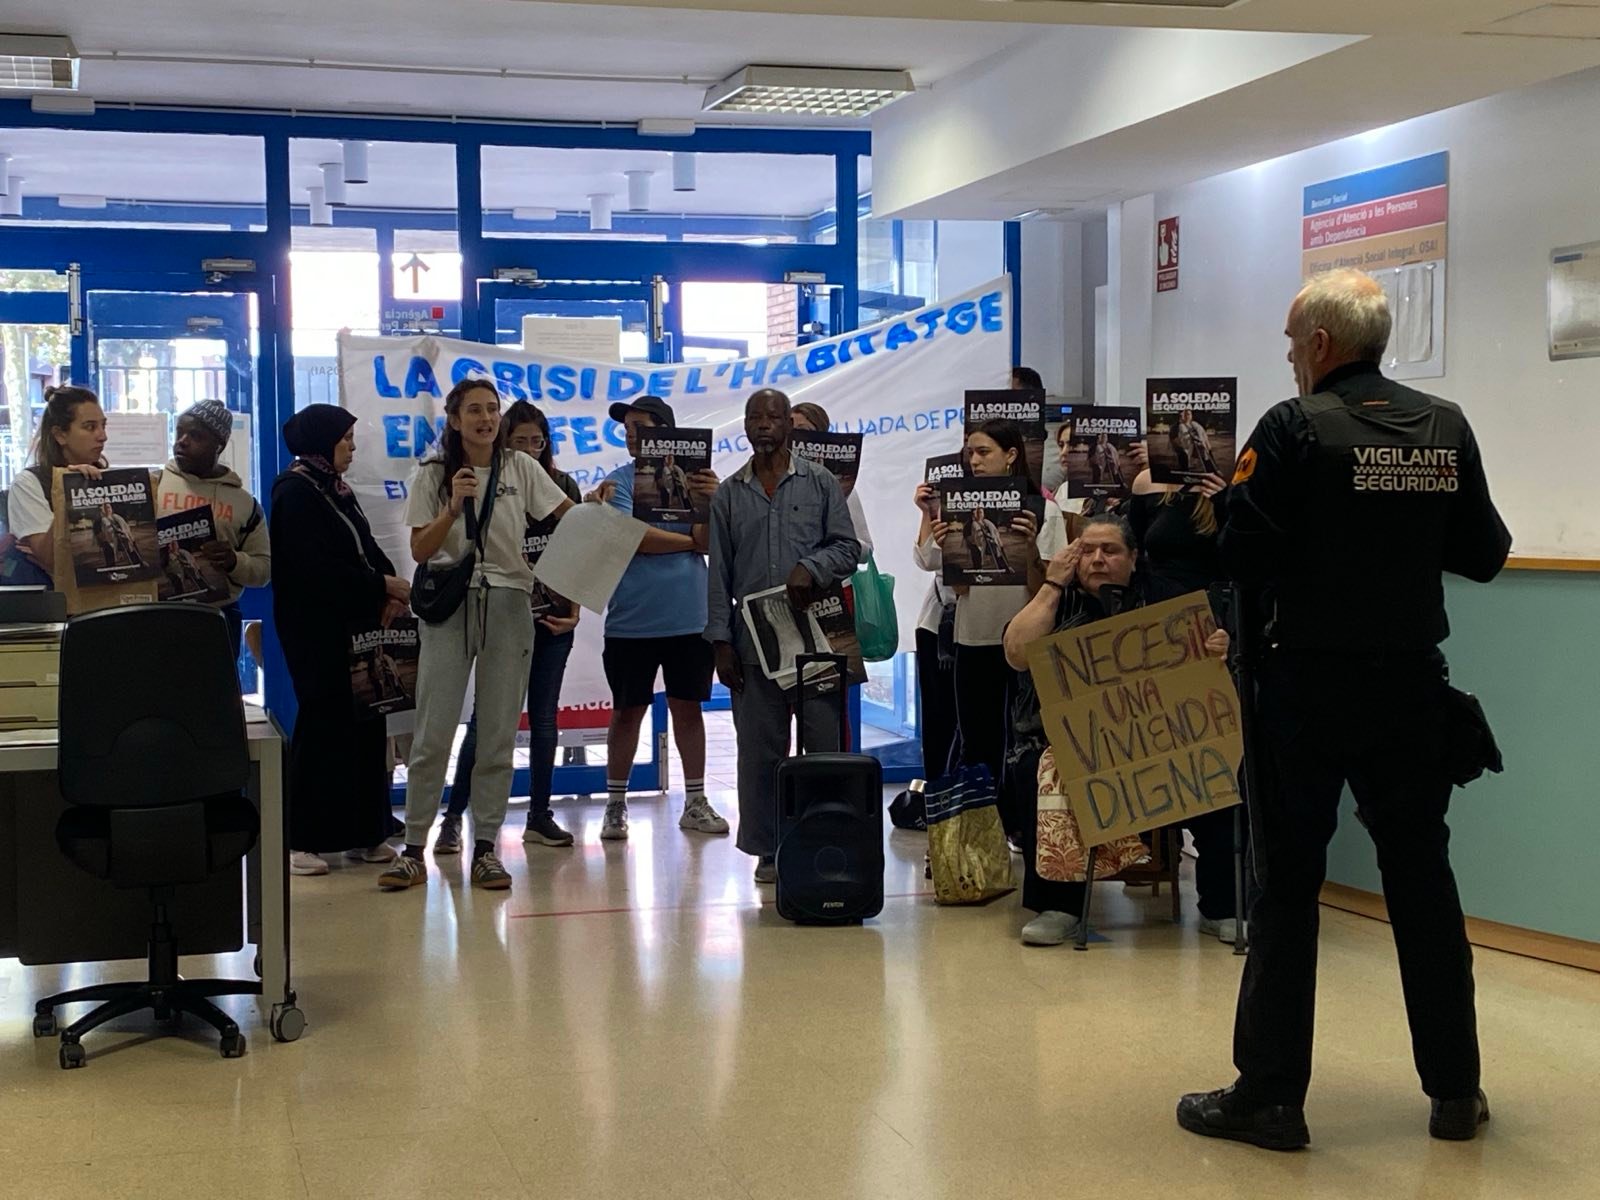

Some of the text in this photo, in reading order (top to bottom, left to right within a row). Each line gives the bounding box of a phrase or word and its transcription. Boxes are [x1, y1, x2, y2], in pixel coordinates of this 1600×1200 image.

[1333, 192, 1348, 204] Social
[1311, 217, 1336, 233] Agència
[1336, 209, 1368, 226] d'Atenció
[1375, 206, 1385, 217] les
[1386, 200, 1418, 215] Persones
[1311, 226, 1366, 247] amb Dependència
[1365, 249, 1386, 264] Social
[373, 355, 442, 399] LA
[607, 368, 677, 401] DE
[685, 291, 1003, 394] L'HABITATGE
[1153, 392, 1230, 403] LA SOLEDAD
[970, 402, 1040, 413] LA SOLEDAD
[1153, 402, 1231, 411] ES QUEDA AL BARRI
[914, 410, 940, 432] DE
[1017, 412, 1040, 420] BARRI
[1076, 418, 1137, 428] LA SOLEDAD
[641, 439, 707, 450] LA SOLEDAD
[792, 440, 857, 453] LA SOLEDAD
[801, 450, 824, 458] QUEDA
[1353, 447, 1458, 467] VIGILANTE
[928, 467, 940, 476] LA
[1353, 475, 1458, 492] SEGURIDAD
[71, 483, 146, 499] LA SOLEDAD
[947, 491, 1020, 502] LA SOLEDAD
[82, 497, 110, 507] QUEDA
[957, 501, 985, 510] QUEDA
[985, 501, 995, 509] AL
[996, 500, 1020, 508] BARRI
[158, 519, 209, 540] SOLEDAD
[352, 629, 417, 645] LA SOLEDAD
[1103, 676, 1164, 726] UNA
[1087, 746, 1239, 830] DIGNA
